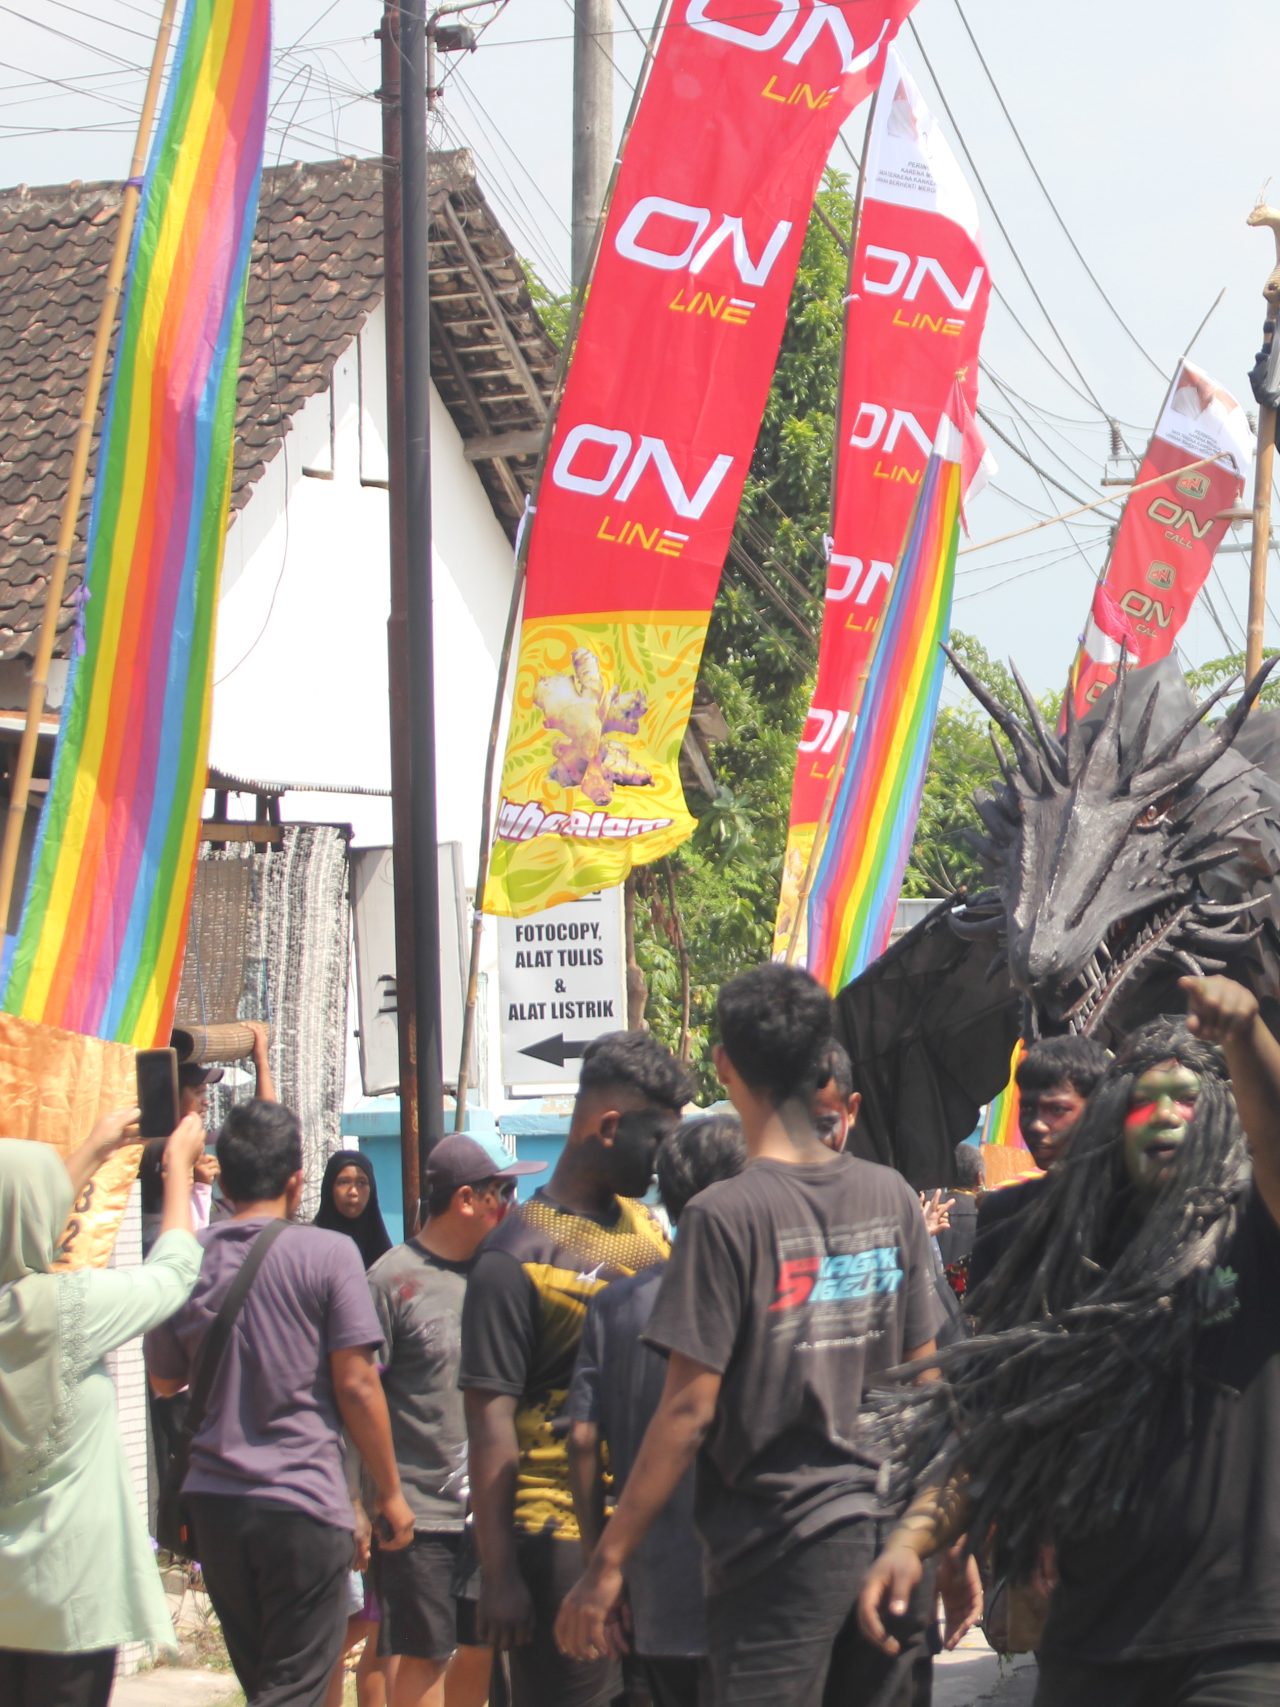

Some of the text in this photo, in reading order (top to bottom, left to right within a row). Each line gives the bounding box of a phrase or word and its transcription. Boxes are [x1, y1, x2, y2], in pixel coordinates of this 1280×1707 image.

[615, 196, 793, 287] ON
[668, 288, 756, 325] LINE
[892, 308, 965, 335] LINE
[552, 423, 735, 520] ON
[873, 461, 924, 485] LIN
[1147, 497, 1215, 539] ON
[596, 515, 690, 557] LINE
[1163, 529, 1193, 550] CALL
[1120, 588, 1175, 628] ON
[515, 922, 602, 942] FOTOCOPY,
[515, 948, 604, 968] ALAT TULIS
[554, 978, 566, 993] &
[508, 1000, 614, 1021] ALAT LISTRIK
